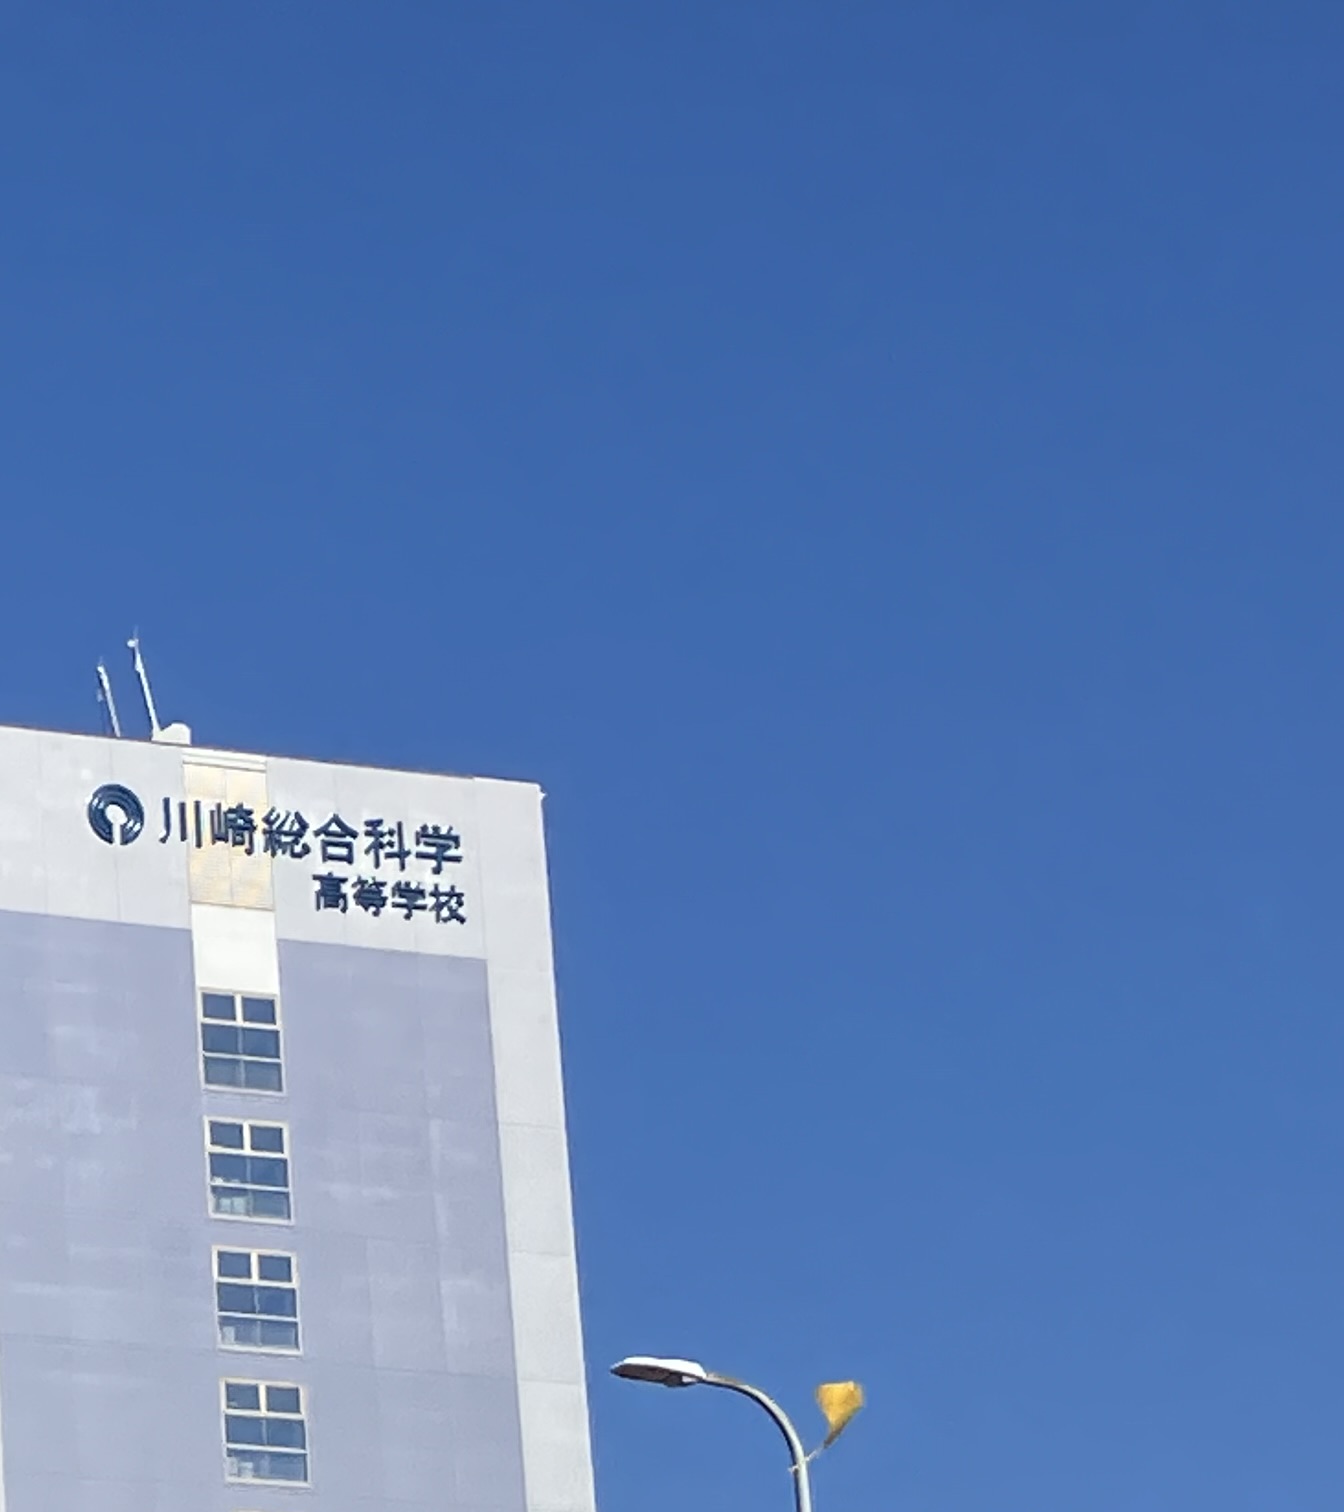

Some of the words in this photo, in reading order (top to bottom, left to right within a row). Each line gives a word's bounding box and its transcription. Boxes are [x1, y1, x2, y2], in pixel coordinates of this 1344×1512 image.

[158, 797, 463, 875] 川崎総合科学
[312, 871, 467, 924] 高等学校
